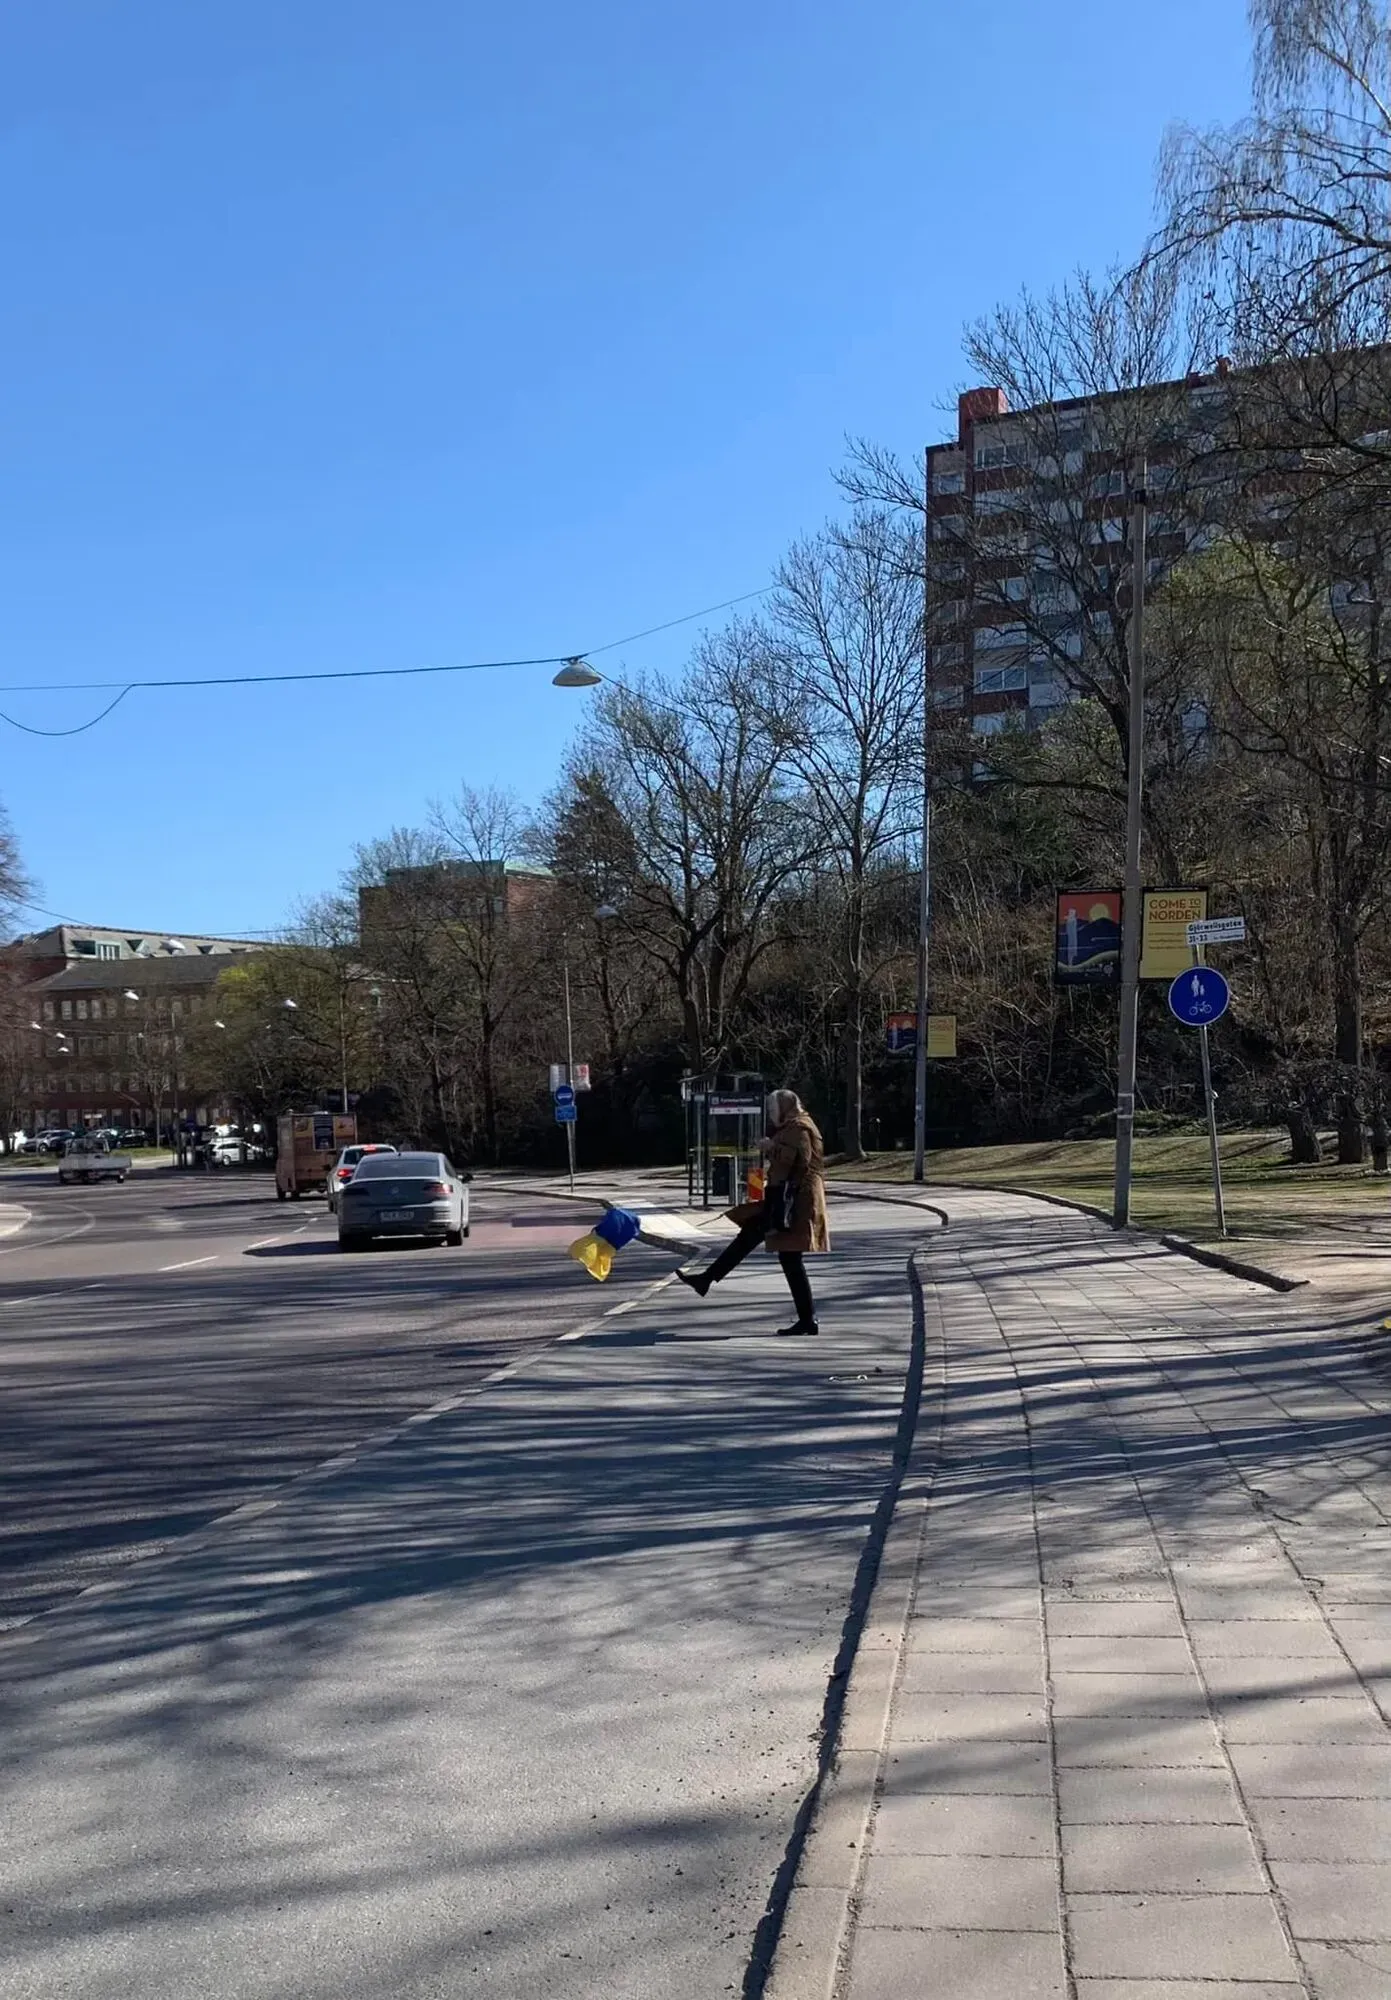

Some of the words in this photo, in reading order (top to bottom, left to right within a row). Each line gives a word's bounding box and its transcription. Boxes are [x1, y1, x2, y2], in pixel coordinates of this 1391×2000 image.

[1149, 899, 1186, 909] COME
[1189, 898, 1201, 906] TO
[1149, 910, 1201, 920] NORDEN
